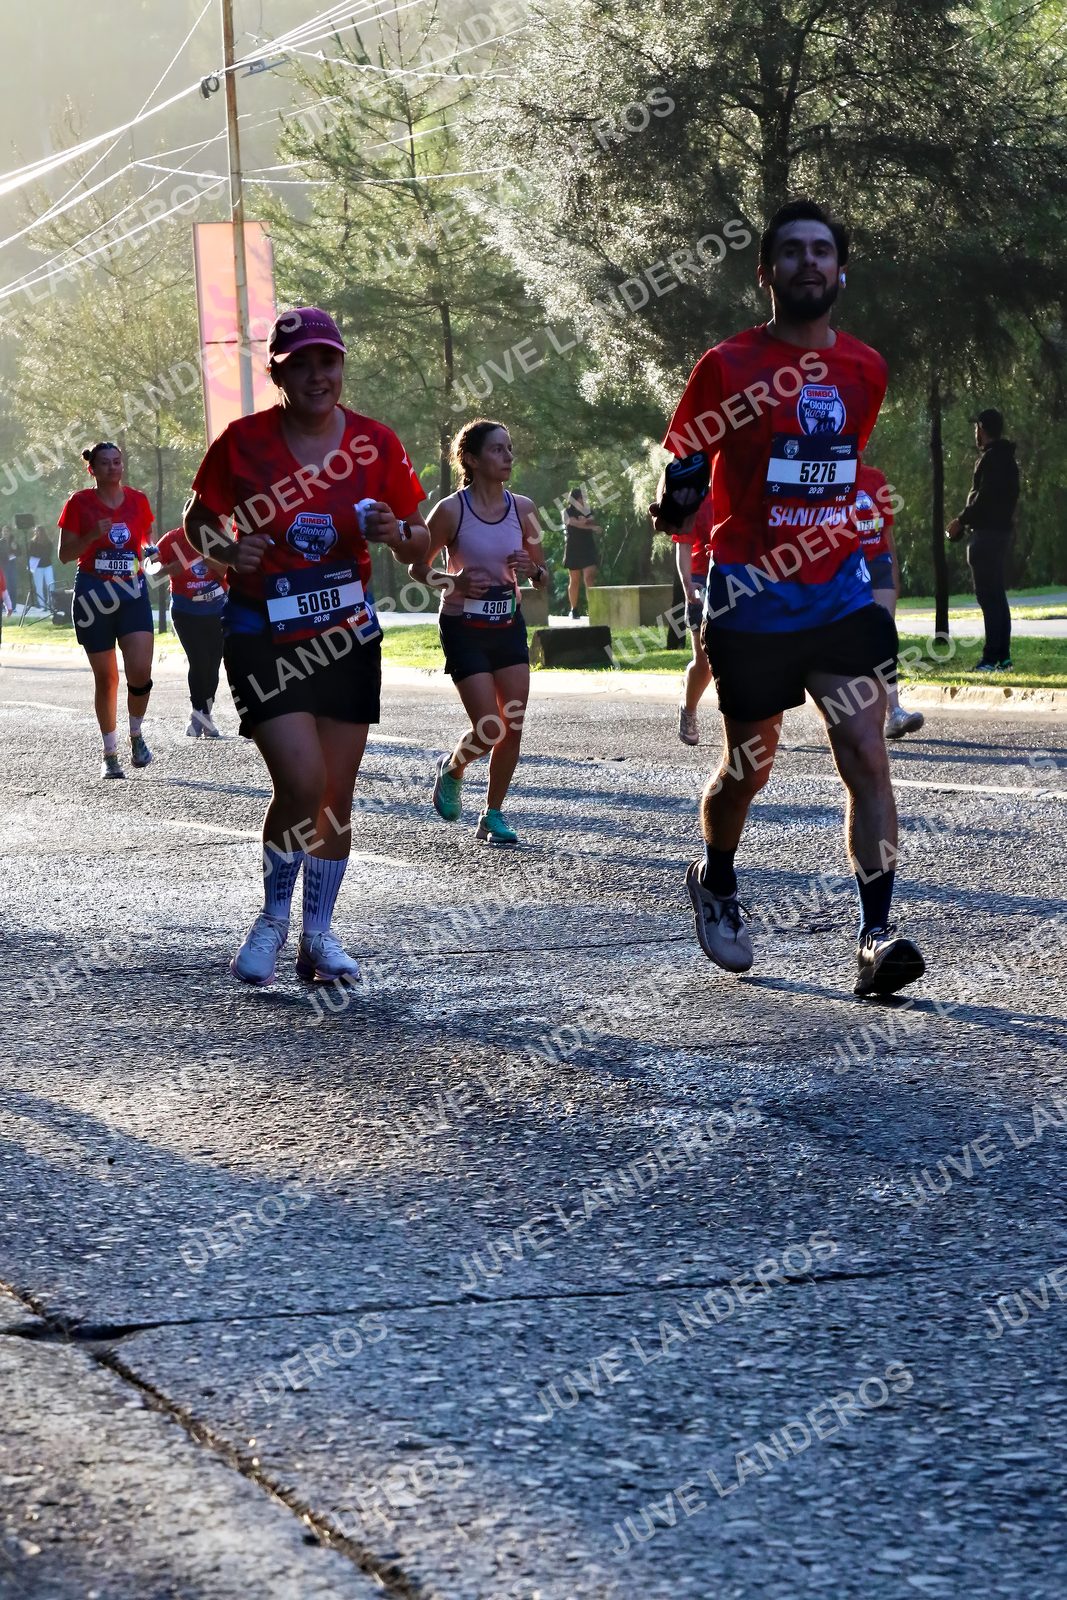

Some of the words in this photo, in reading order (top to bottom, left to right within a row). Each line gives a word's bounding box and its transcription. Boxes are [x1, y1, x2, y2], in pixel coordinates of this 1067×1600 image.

[806, 390, 833, 398] BIMBO
[809, 400, 834, 411] Global
[804, 408, 826, 419] Race
[799, 462, 837, 483] 5276
[300, 526, 328, 537] Global
[108, 560, 128, 570] 4036
[296, 588, 341, 616] 5068
[482, 601, 508, 614] 4308
